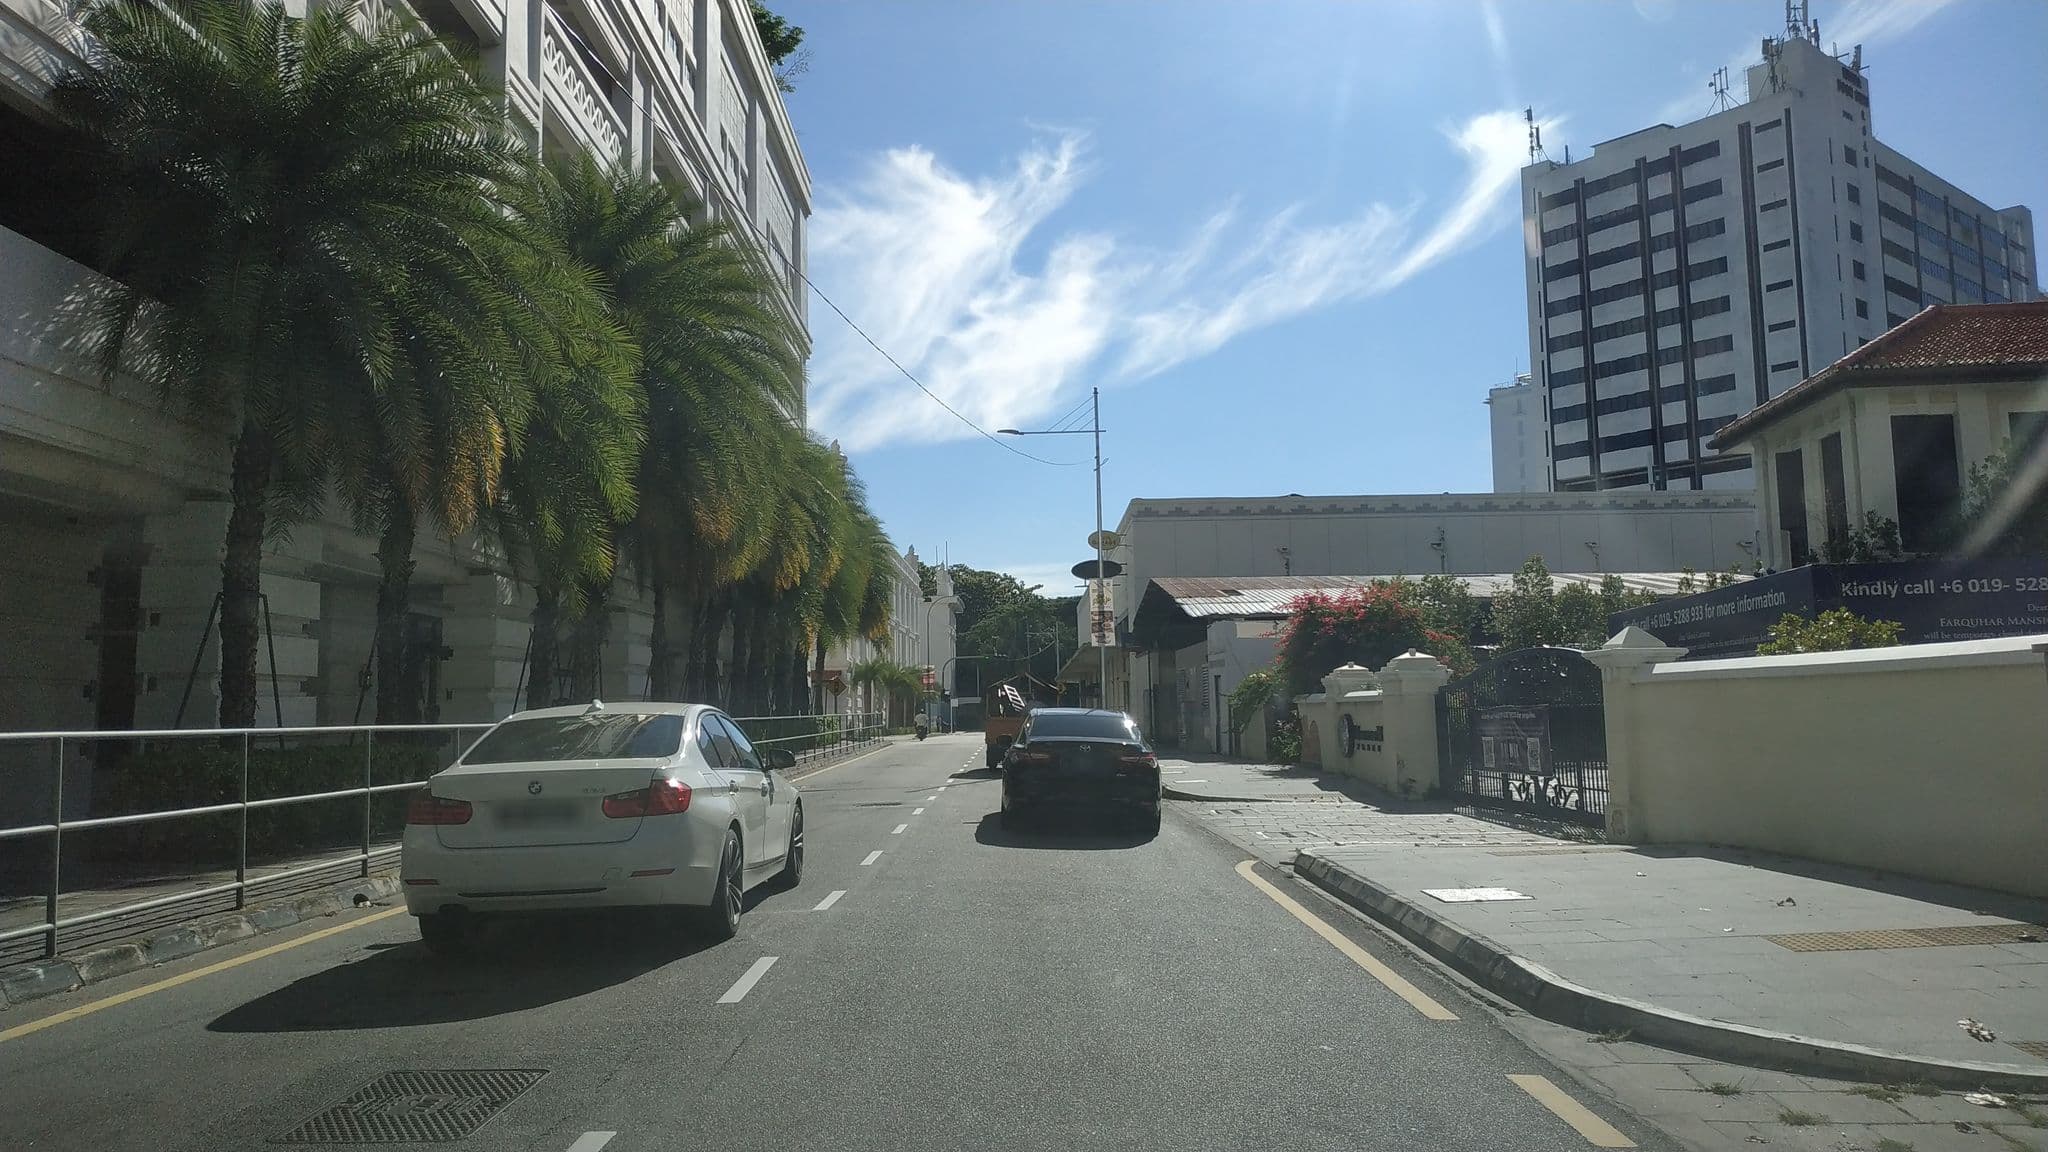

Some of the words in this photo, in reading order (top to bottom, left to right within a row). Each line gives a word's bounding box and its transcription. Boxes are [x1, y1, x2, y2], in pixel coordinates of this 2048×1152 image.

[1841, 580, 1898, 598] Kindly
[1904, 579, 1935, 595] call
[1940, 579, 1963, 593] +6
[1968, 578, 2010, 593] 019-
[1673, 608, 1690, 625] 5288
[1691, 605, 1703, 622] 933
[1705, 603, 1716, 618] for
[1716, 601, 1736, 616] more
[1736, 588, 1786, 613] information
[1940, 616, 2004, 628] FARQUHAR
[2007, 616, 2048, 626] MANSI
[1923, 631, 1940, 640] will
